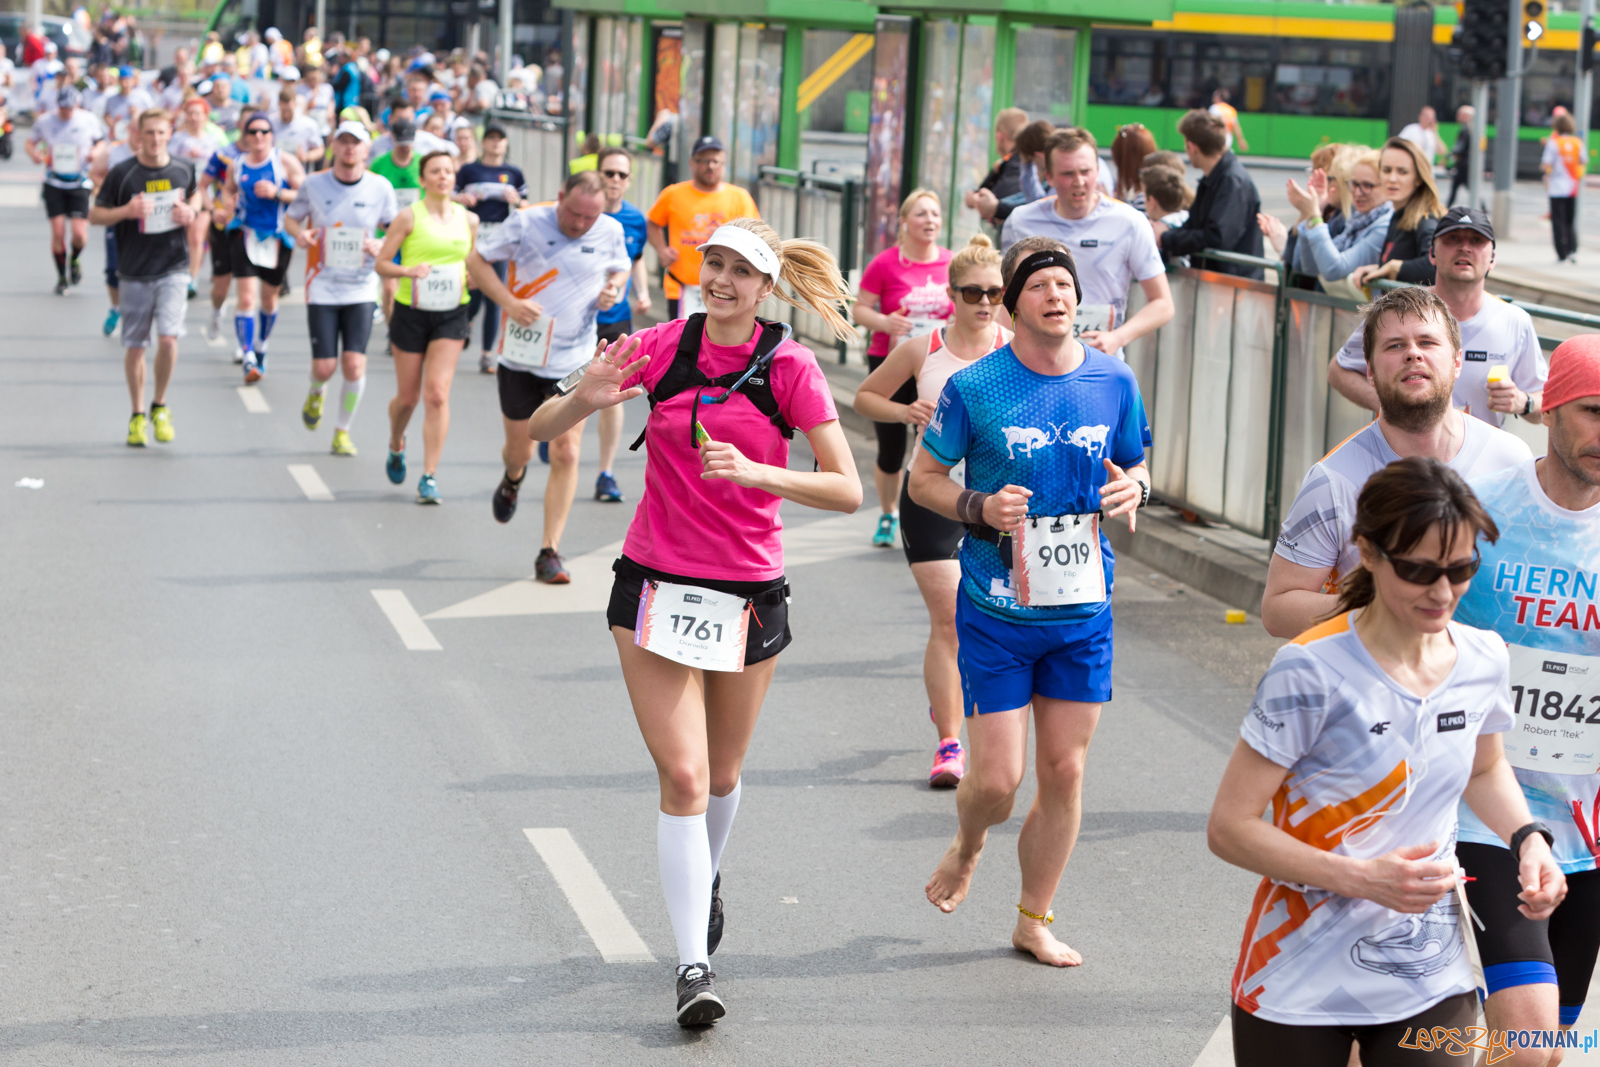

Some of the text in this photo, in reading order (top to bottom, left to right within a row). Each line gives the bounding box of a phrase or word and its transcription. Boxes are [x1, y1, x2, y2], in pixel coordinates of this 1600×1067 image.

[427, 279, 453, 292] 1951
[508, 323, 542, 344] 9607
[1038, 542, 1090, 567] 9019
[670, 614, 723, 643] 1761
[679, 639, 708, 650] Daniela
[1545, 663, 1566, 672] 11.PKO
[1511, 685, 1600, 725] 11842
[1369, 721, 1391, 735] 4F
[1440, 715, 1465, 728] 11.PKO
[1523, 723, 1557, 737] Robert
